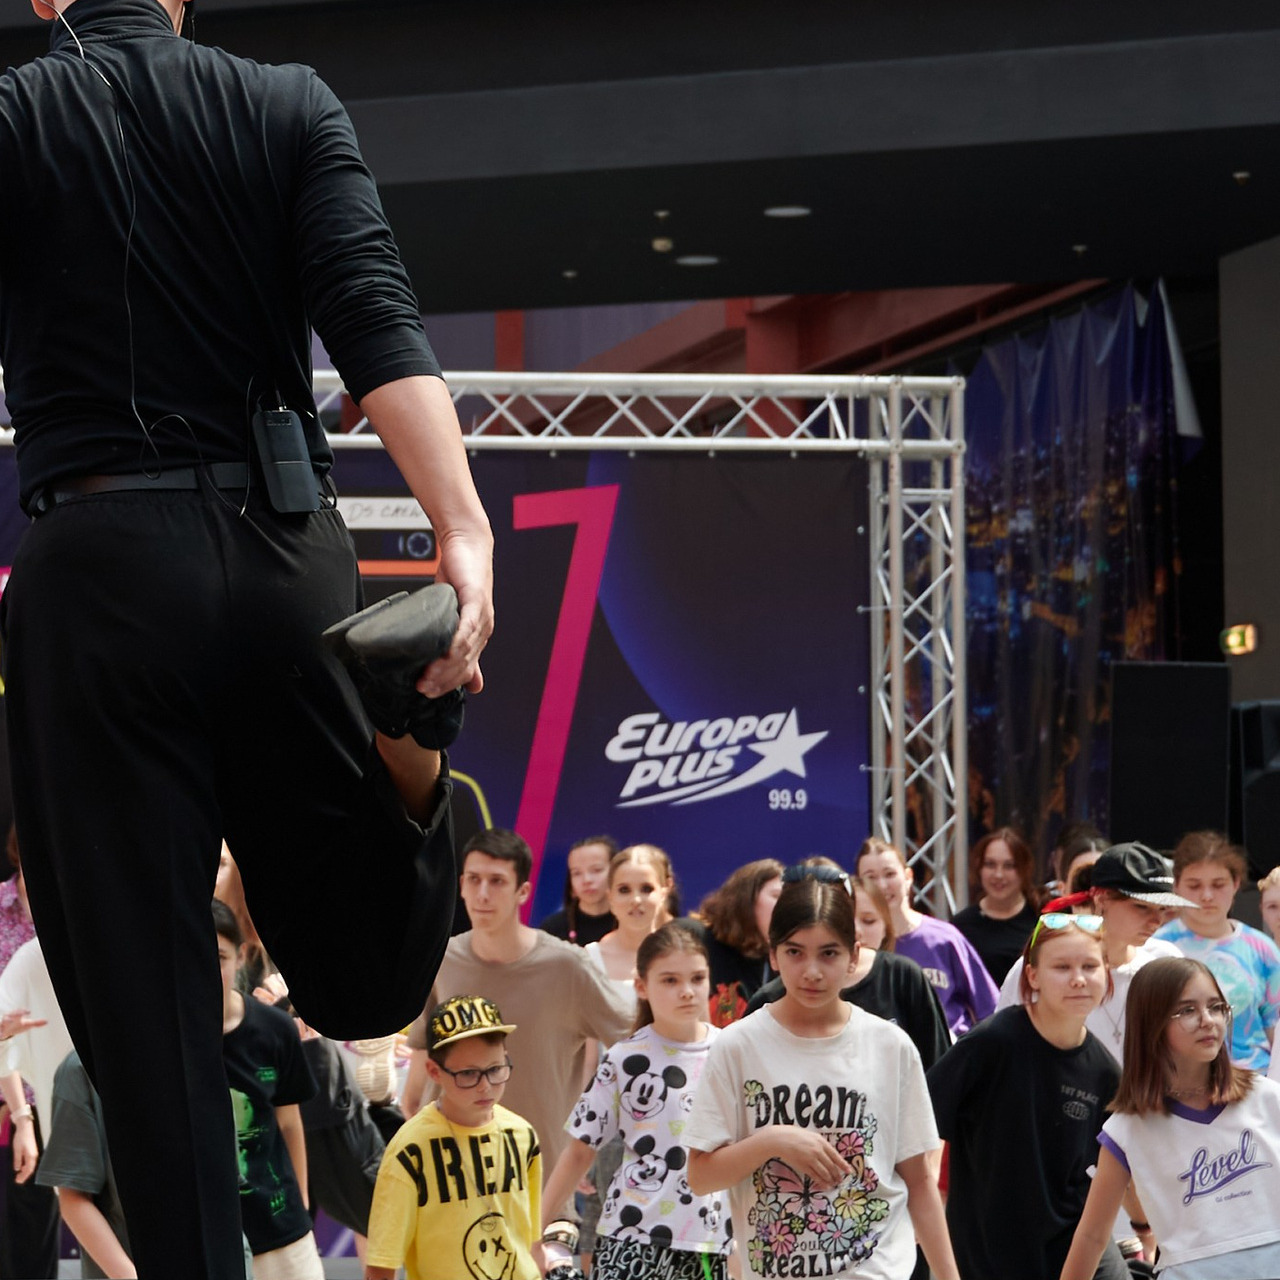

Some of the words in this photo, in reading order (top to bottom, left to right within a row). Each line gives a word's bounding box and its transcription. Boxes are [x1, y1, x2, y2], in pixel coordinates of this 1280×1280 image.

[768, 788, 808, 810] 99.9
[439, 1001, 497, 1033] OMG
[1177, 1127, 1258, 1208] Level
